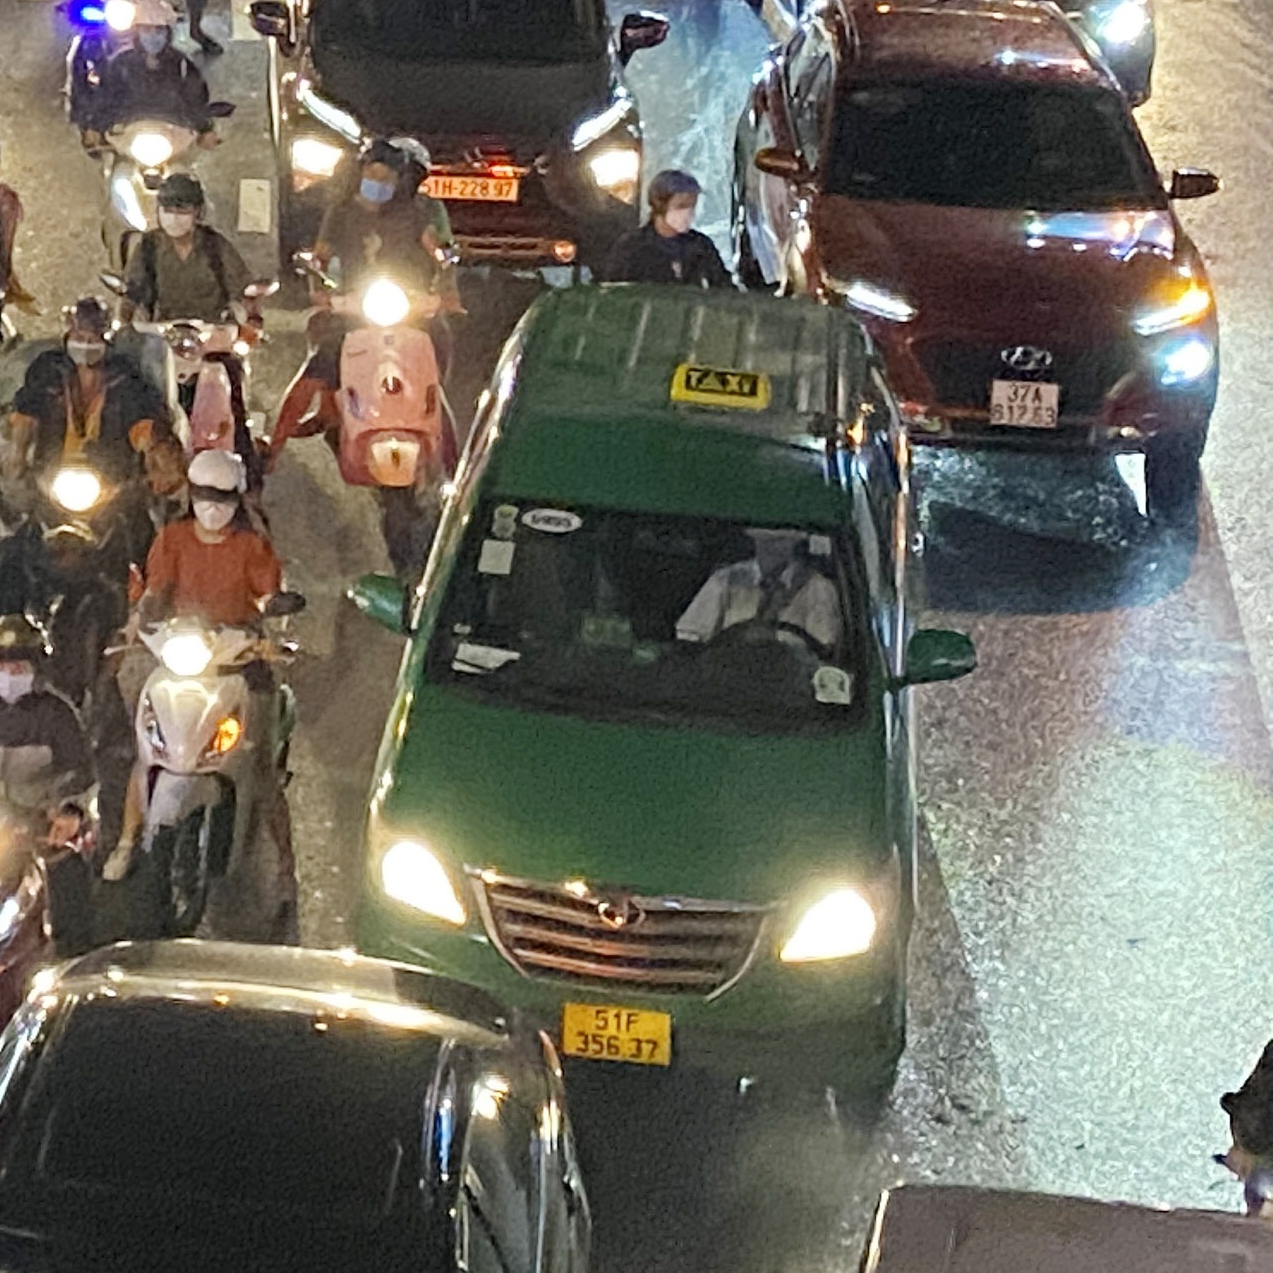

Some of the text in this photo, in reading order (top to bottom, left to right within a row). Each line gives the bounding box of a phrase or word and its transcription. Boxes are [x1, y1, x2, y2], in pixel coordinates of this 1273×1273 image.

[687, 370, 753, 395] TAXI
[1007, 384, 1043, 404] 37A
[594, 1008, 640, 1033] 51F
